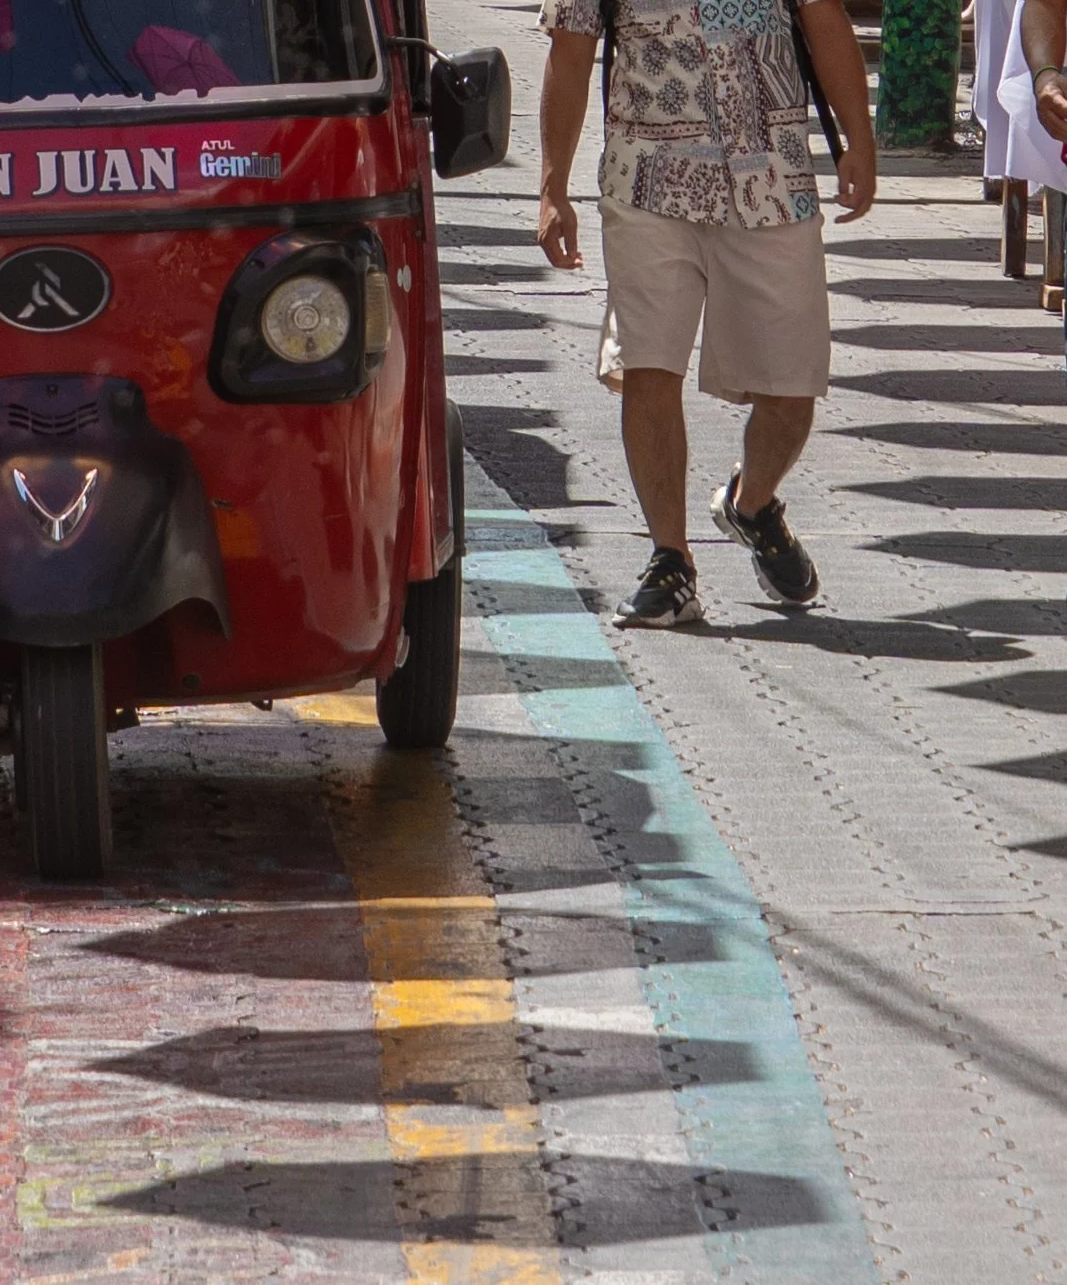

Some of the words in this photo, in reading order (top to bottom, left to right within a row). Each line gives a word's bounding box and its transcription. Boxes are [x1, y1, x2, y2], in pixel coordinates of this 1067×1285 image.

[201, 139, 236, 151] ATUL
[32, 146, 176, 196] JUAN
[199, 151, 282, 179] Gemini
